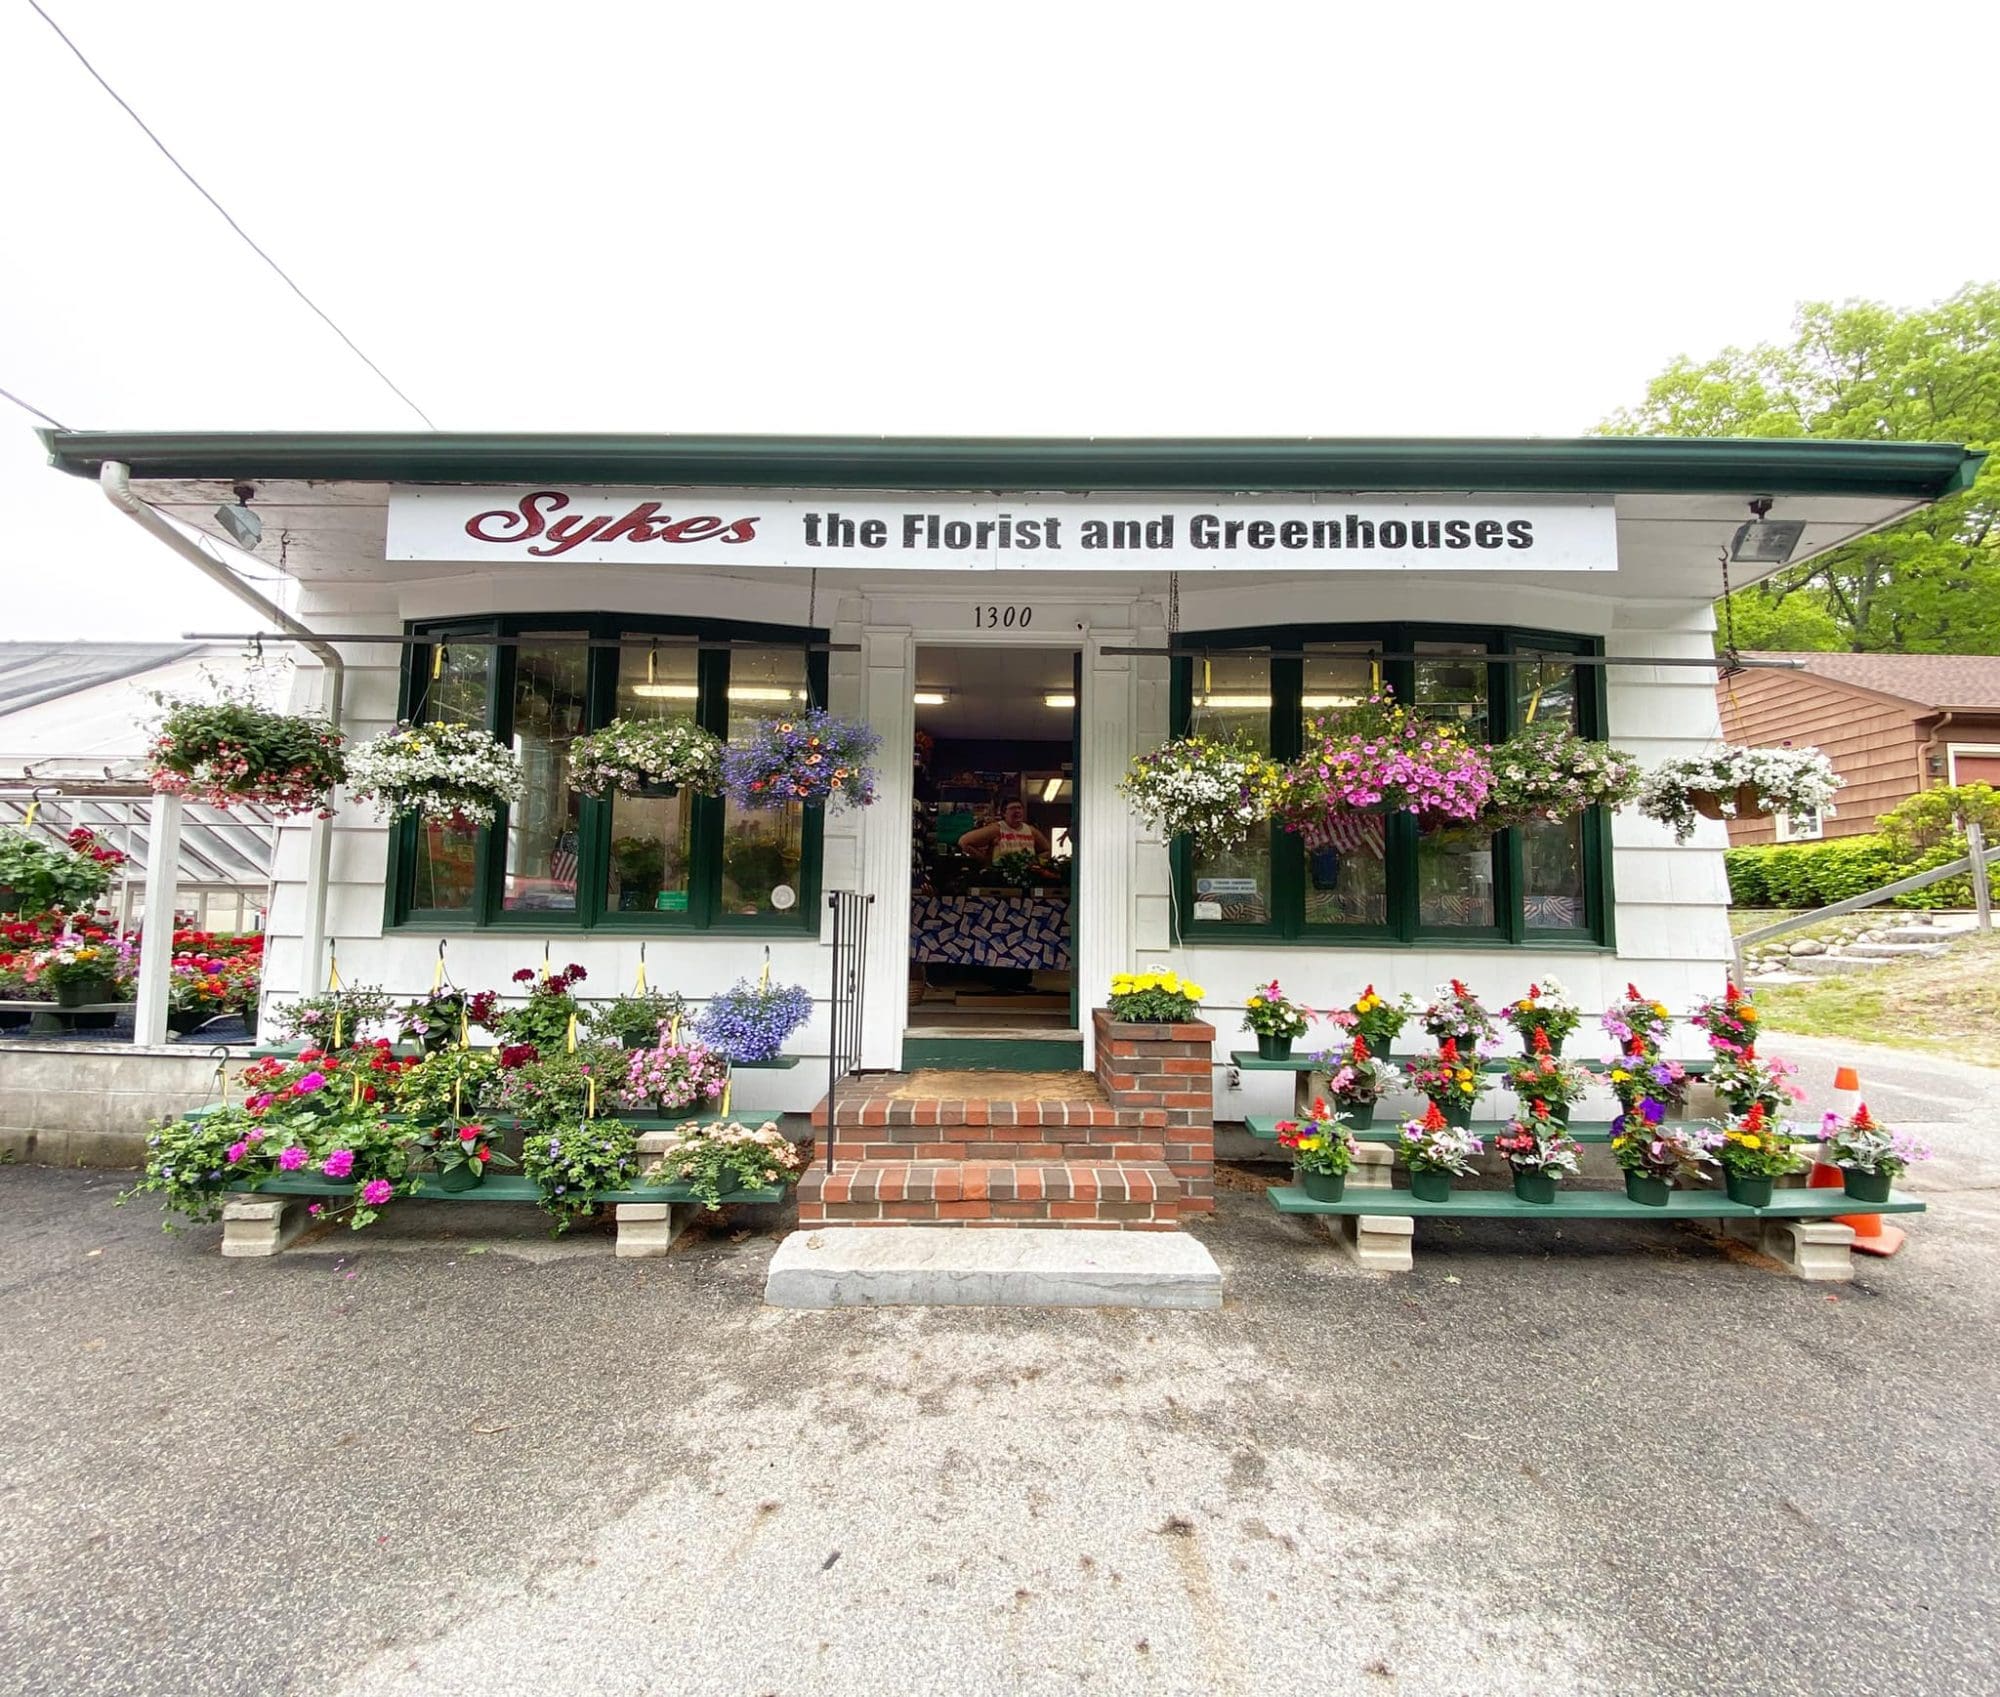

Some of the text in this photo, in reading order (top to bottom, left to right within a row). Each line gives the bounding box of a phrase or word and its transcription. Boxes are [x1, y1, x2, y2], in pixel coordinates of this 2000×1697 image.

[466, 490, 1535, 556] Sykes the Florist and Greenhouses
[974, 605, 1032, 629] 1300
